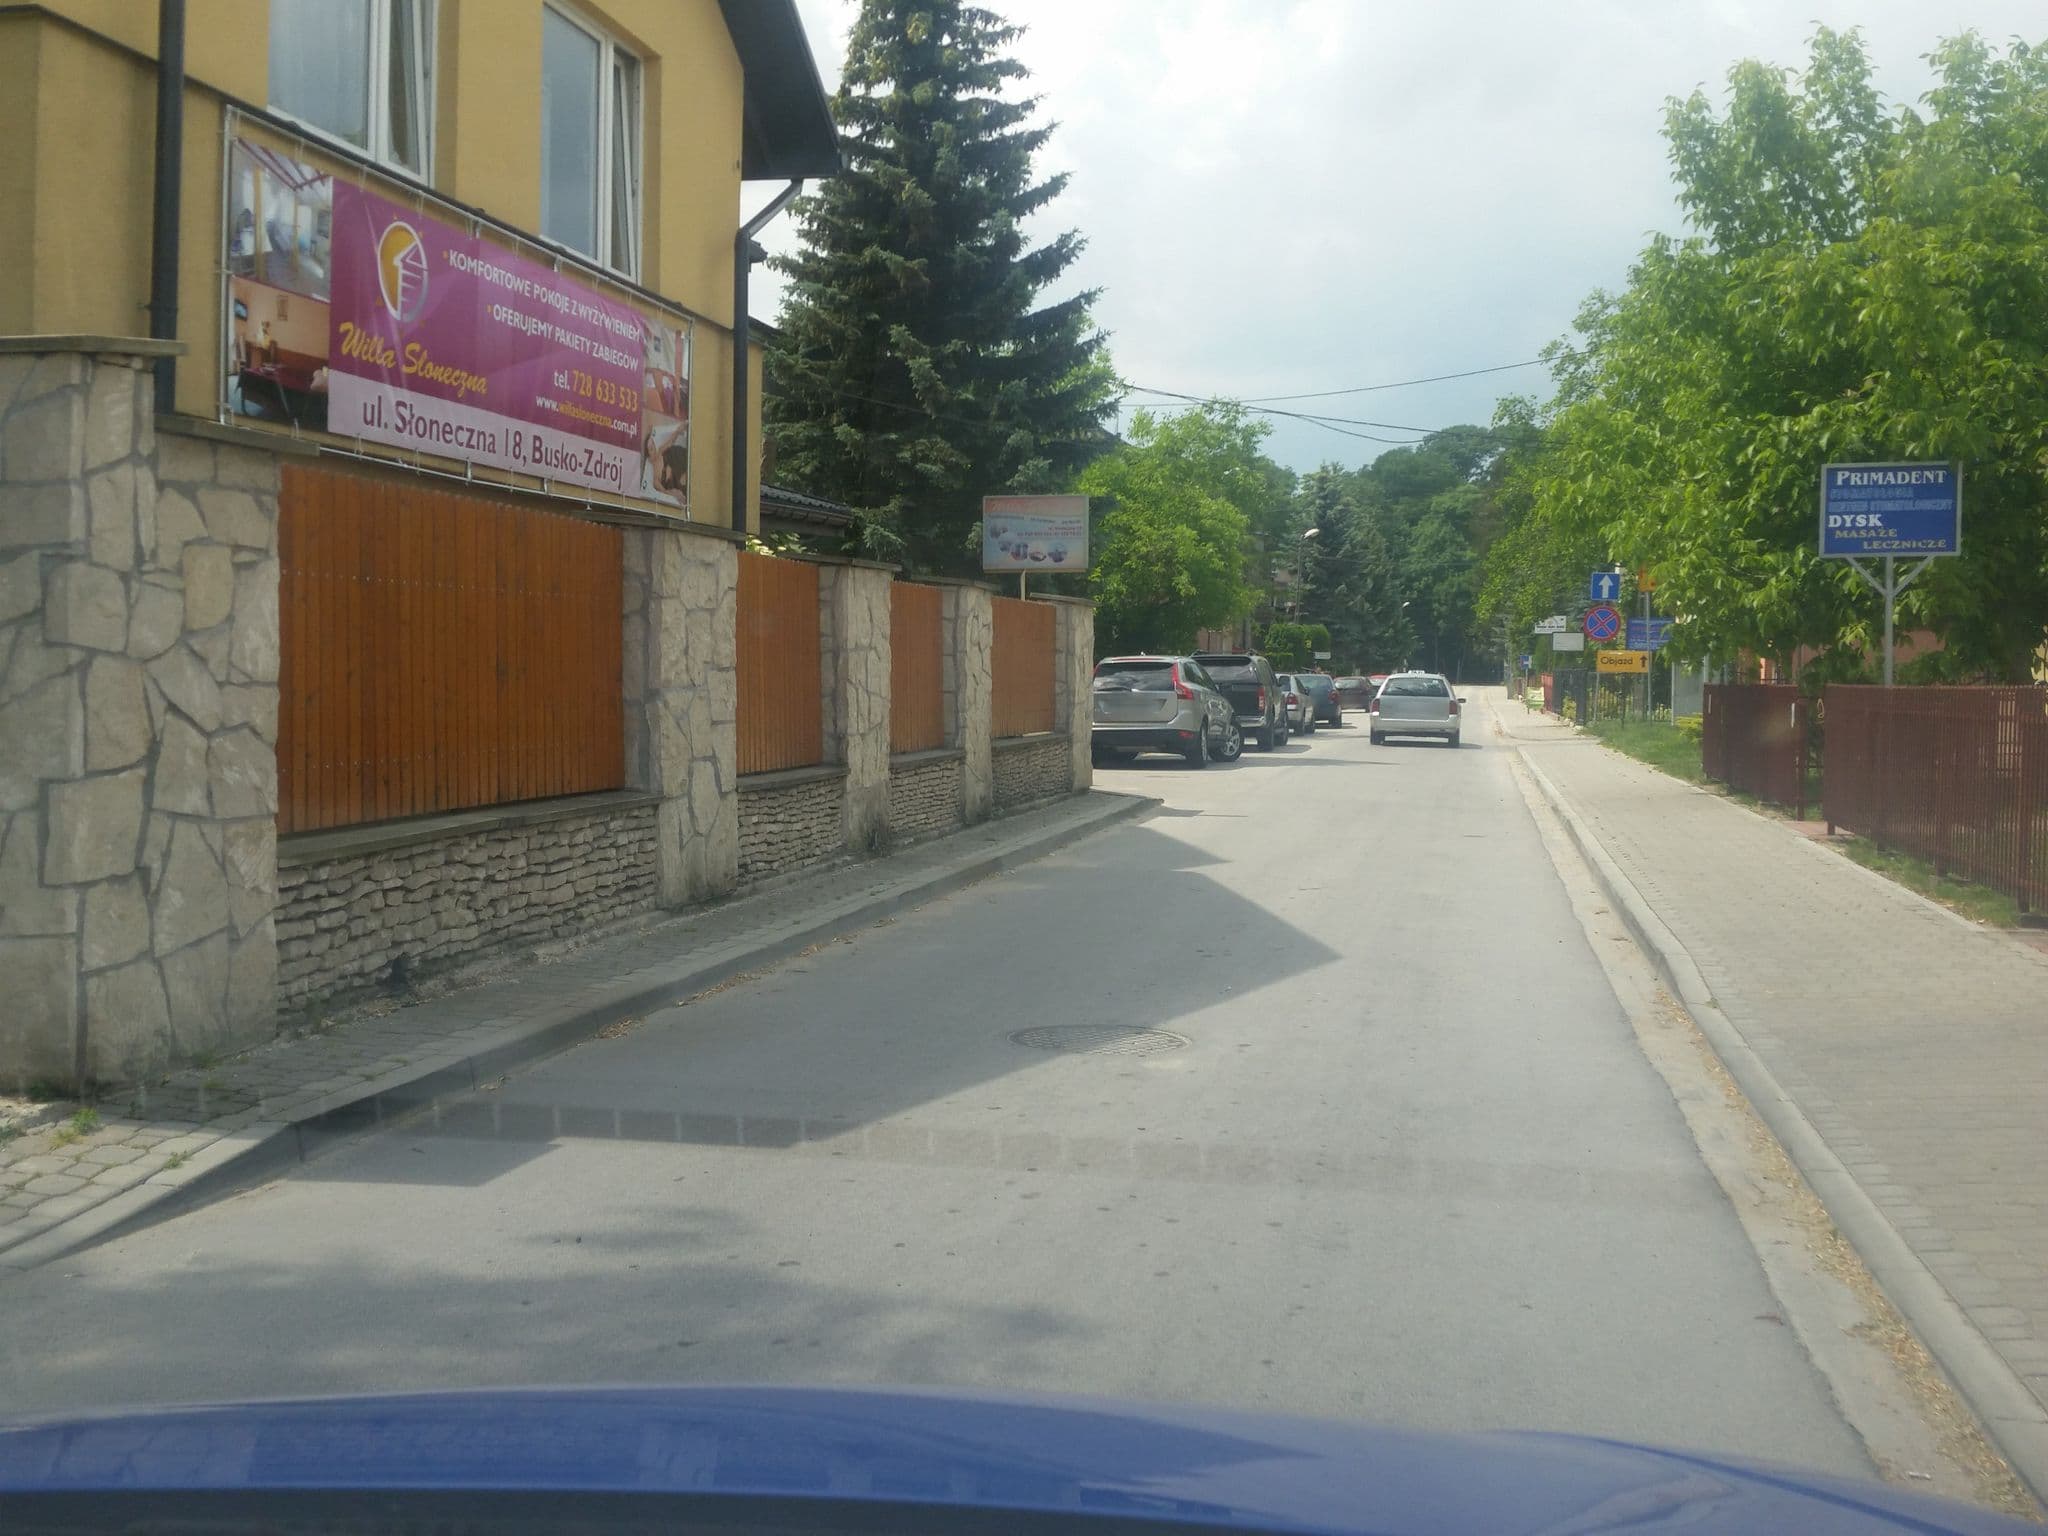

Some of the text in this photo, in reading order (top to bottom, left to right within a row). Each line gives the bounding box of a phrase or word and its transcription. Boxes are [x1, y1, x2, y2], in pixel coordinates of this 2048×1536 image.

[449, 250, 531, 297] KOMFORTOWE
[534, 285, 570, 315] POKOJE
[493, 304, 553, 340] OFERUJEMY
[555, 326, 591, 354] PAKIETY
[339, 321, 396, 369] Willa
[553, 368, 638, 413] tel. 728 633 533
[362, 396, 624, 491] ul. Słoneczna 18, Busko-Zdrój
[1836, 470, 1947, 486] PRIMADENT
[1828, 513, 1883, 528] DYSK
[1835, 528, 1898, 539] MASAŻE
[1863, 539, 1947, 550] LECZNICZE
[1600, 656, 1634, 667] Objazd
